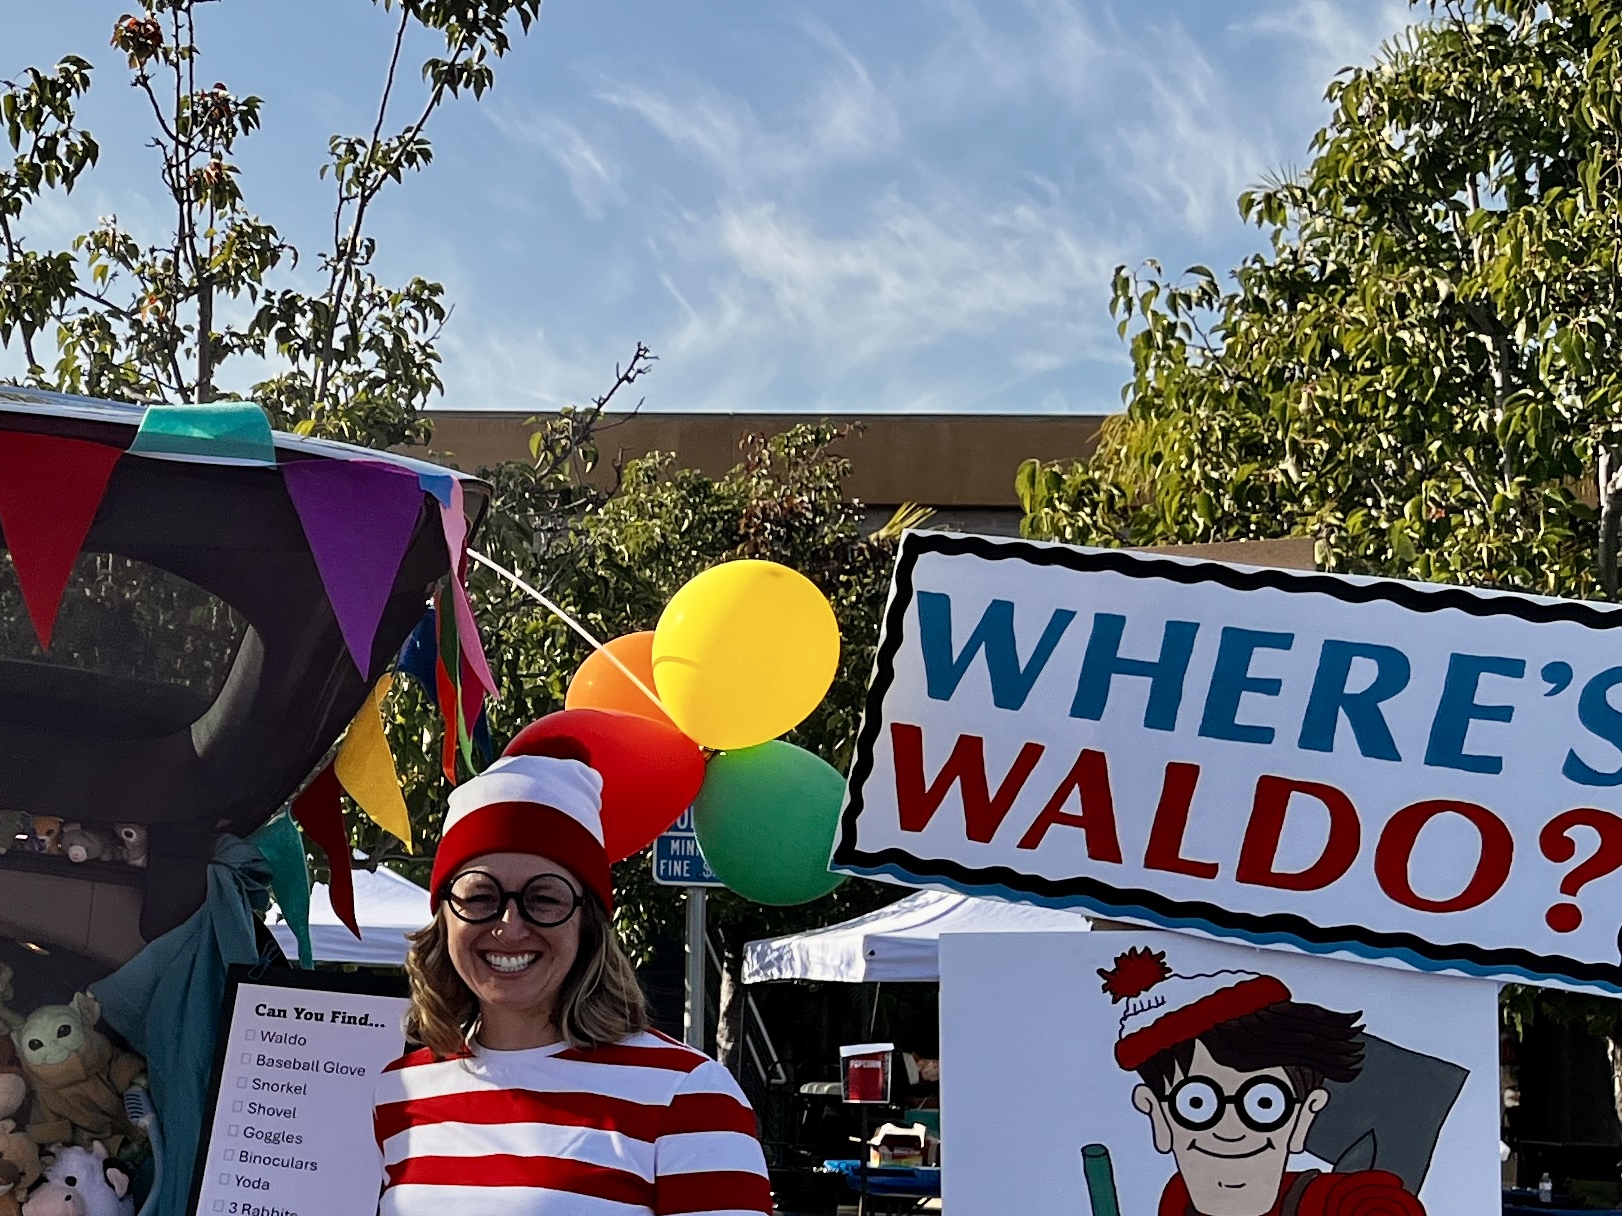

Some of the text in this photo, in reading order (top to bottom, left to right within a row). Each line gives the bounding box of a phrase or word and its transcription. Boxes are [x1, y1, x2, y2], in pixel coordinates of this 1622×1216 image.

[916, 590, 1622, 788] WHERE'S
[891, 722, 1622, 934] WALDO?
[659, 859, 691, 878] FINE
[254, 1003, 386, 1028] Can You Find...
[260, 1030, 307, 1047] Waldo
[256, 1053, 366, 1077] Baseball Glove
[251, 1078, 307, 1096] Snorkel
[247, 1102, 297, 1119] Shovel
[243, 1126, 303, 1145] Goggles
[238, 1150, 318, 1172] Binoculars
[235, 1174, 271, 1191] Yoda
[228, 1201, 238, 1215] 3
